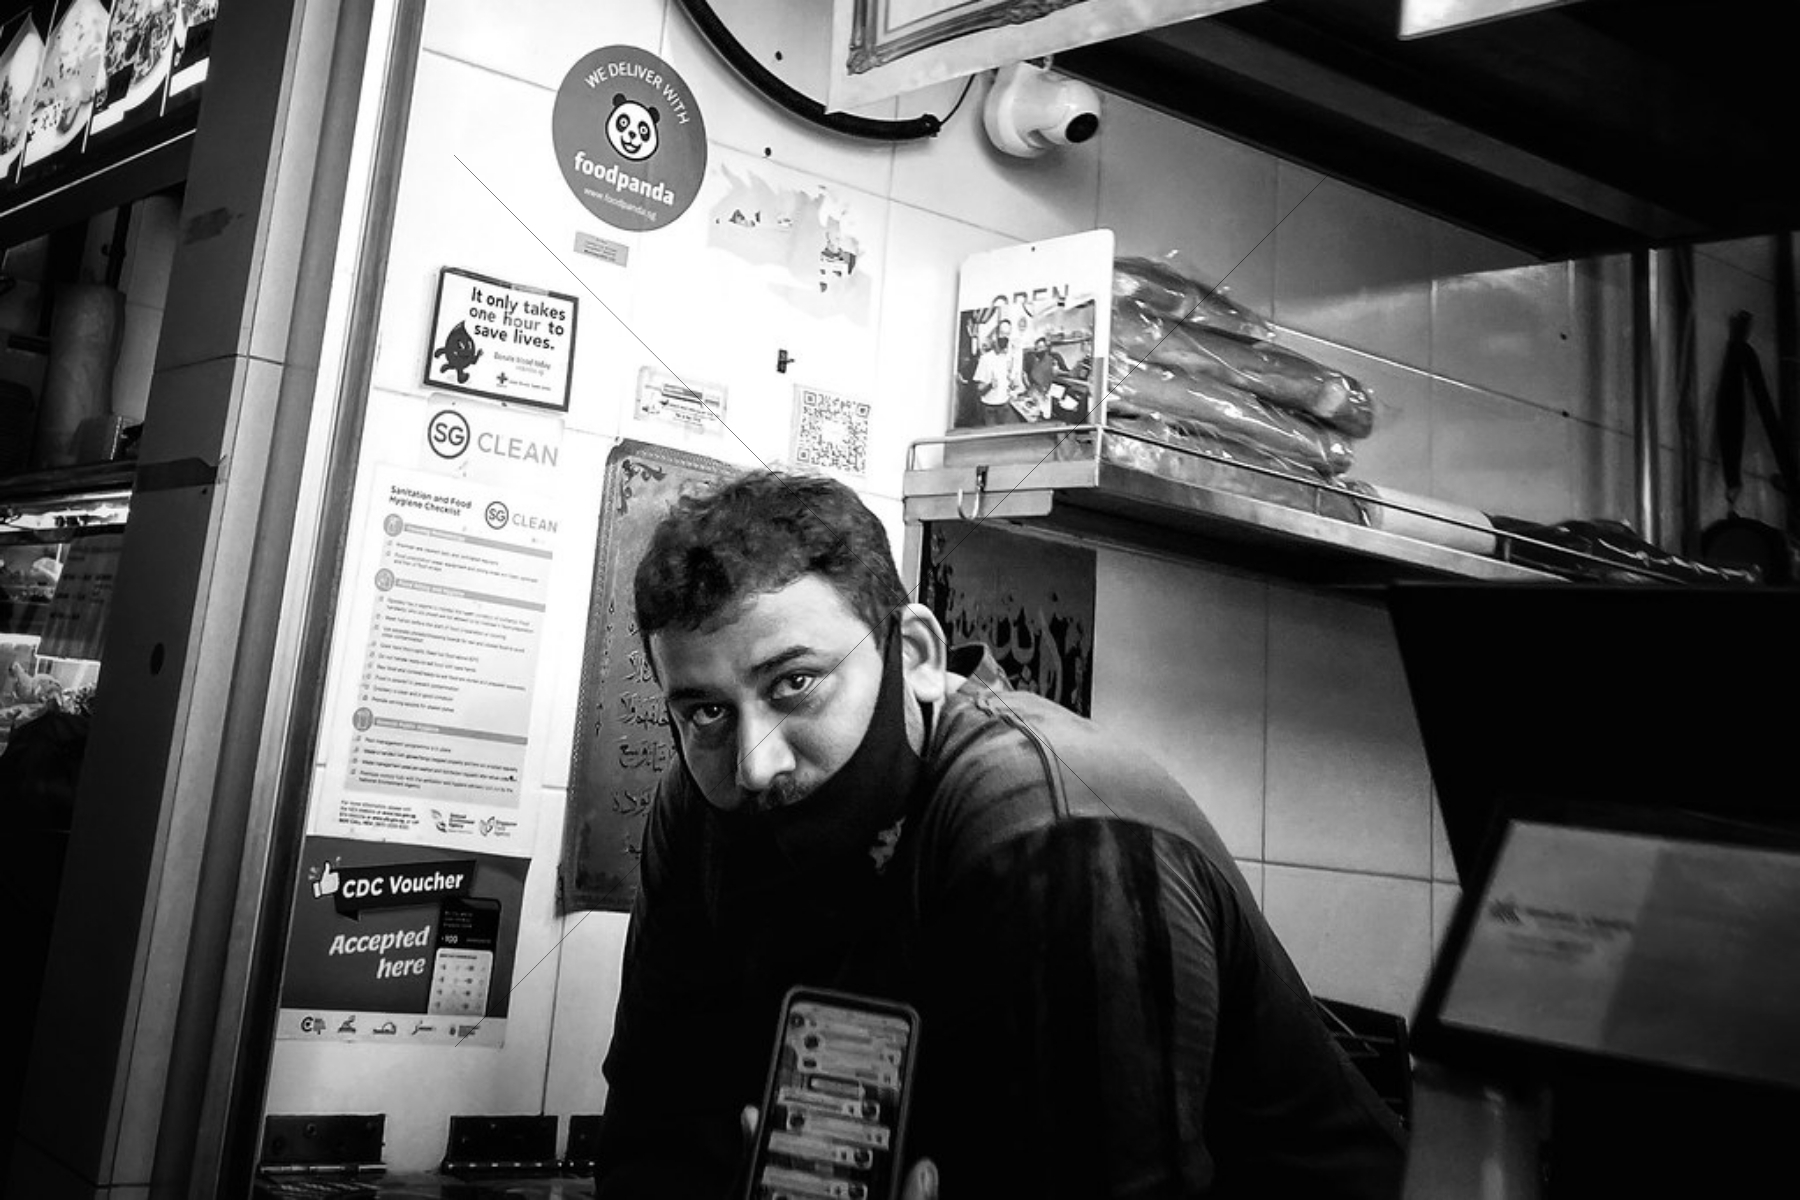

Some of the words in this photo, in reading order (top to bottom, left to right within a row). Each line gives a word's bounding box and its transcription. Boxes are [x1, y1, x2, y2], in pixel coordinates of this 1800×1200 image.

[585, 67, 608, 88] WE
[608, 61, 663, 89] DELIVER
[662, 84, 691, 125] WITH
[574, 151, 675, 206] foodpanda
[471, 286, 483, 303] It
[486, 294, 518, 315] only
[523, 300, 566, 321] takes
[469, 306, 497, 322] one
[503, 311, 541, 331] hour
[548, 321, 564, 336] to
[474, 324, 508, 342] save
[513, 328, 555, 350] lives.
[433, 422, 465, 446] SG
[477, 432, 559, 467] CLEAN
[389, 495, 423, 509] Hygiene
[424, 501, 461, 516] Checklist
[391, 485, 432, 501] Sanitation
[433, 495, 450, 504] and
[450, 497, 472, 509] Food
[488, 508, 506, 522] SG
[511, 513, 558, 533] CLEAN
[342, 877, 384, 898] CDC
[389, 871, 464, 895] Voucher
[328, 925, 431, 956] Accepted
[376, 957, 426, 979] here
